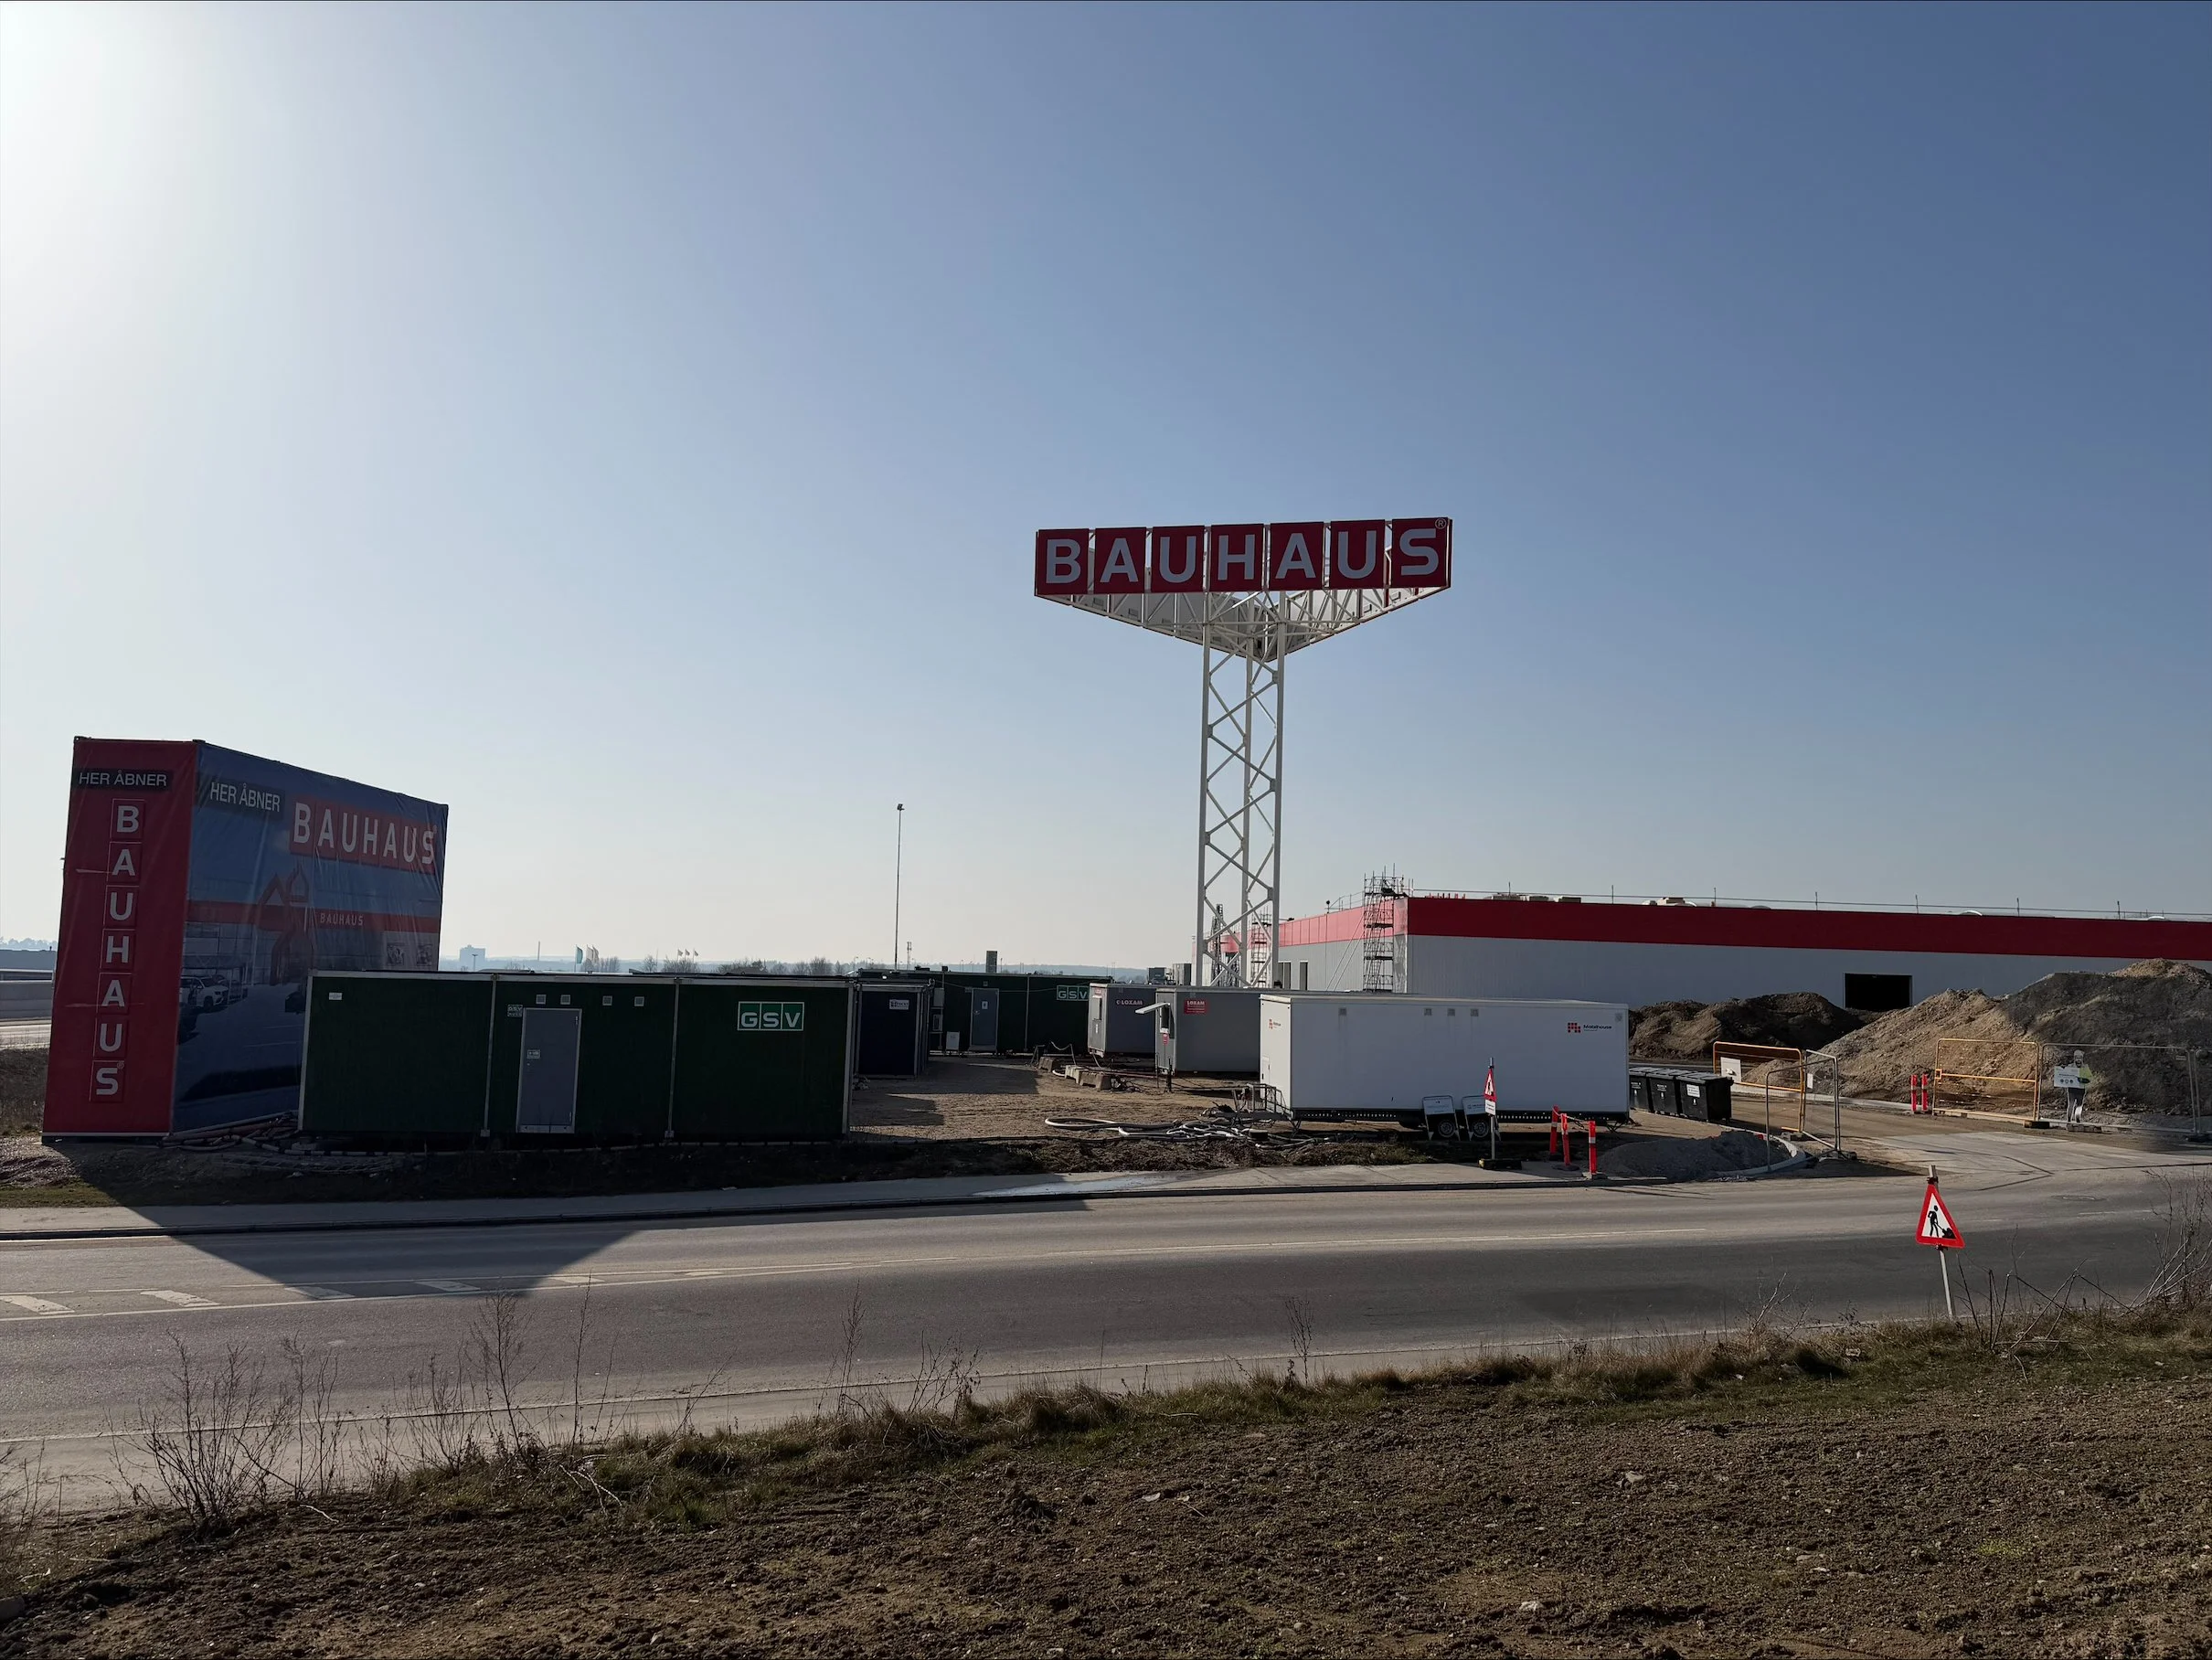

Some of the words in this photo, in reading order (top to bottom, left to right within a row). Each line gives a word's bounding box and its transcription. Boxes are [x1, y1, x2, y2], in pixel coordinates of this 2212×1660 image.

[1046, 528, 1440, 584] BAUHAUS
[79, 772, 110, 784] HER
[114, 770, 167, 786] ÅBNER
[210, 782, 237, 803] HER
[239, 782, 281, 812] ÅBNER
[293, 802, 434, 865] BAUHAUS
[320, 913, 364, 926] BAUHAUS
[96, 805, 140, 1095] BAUHAUS
[1058, 990, 1088, 999] GSV
[740, 1012, 801, 1027] GSV
